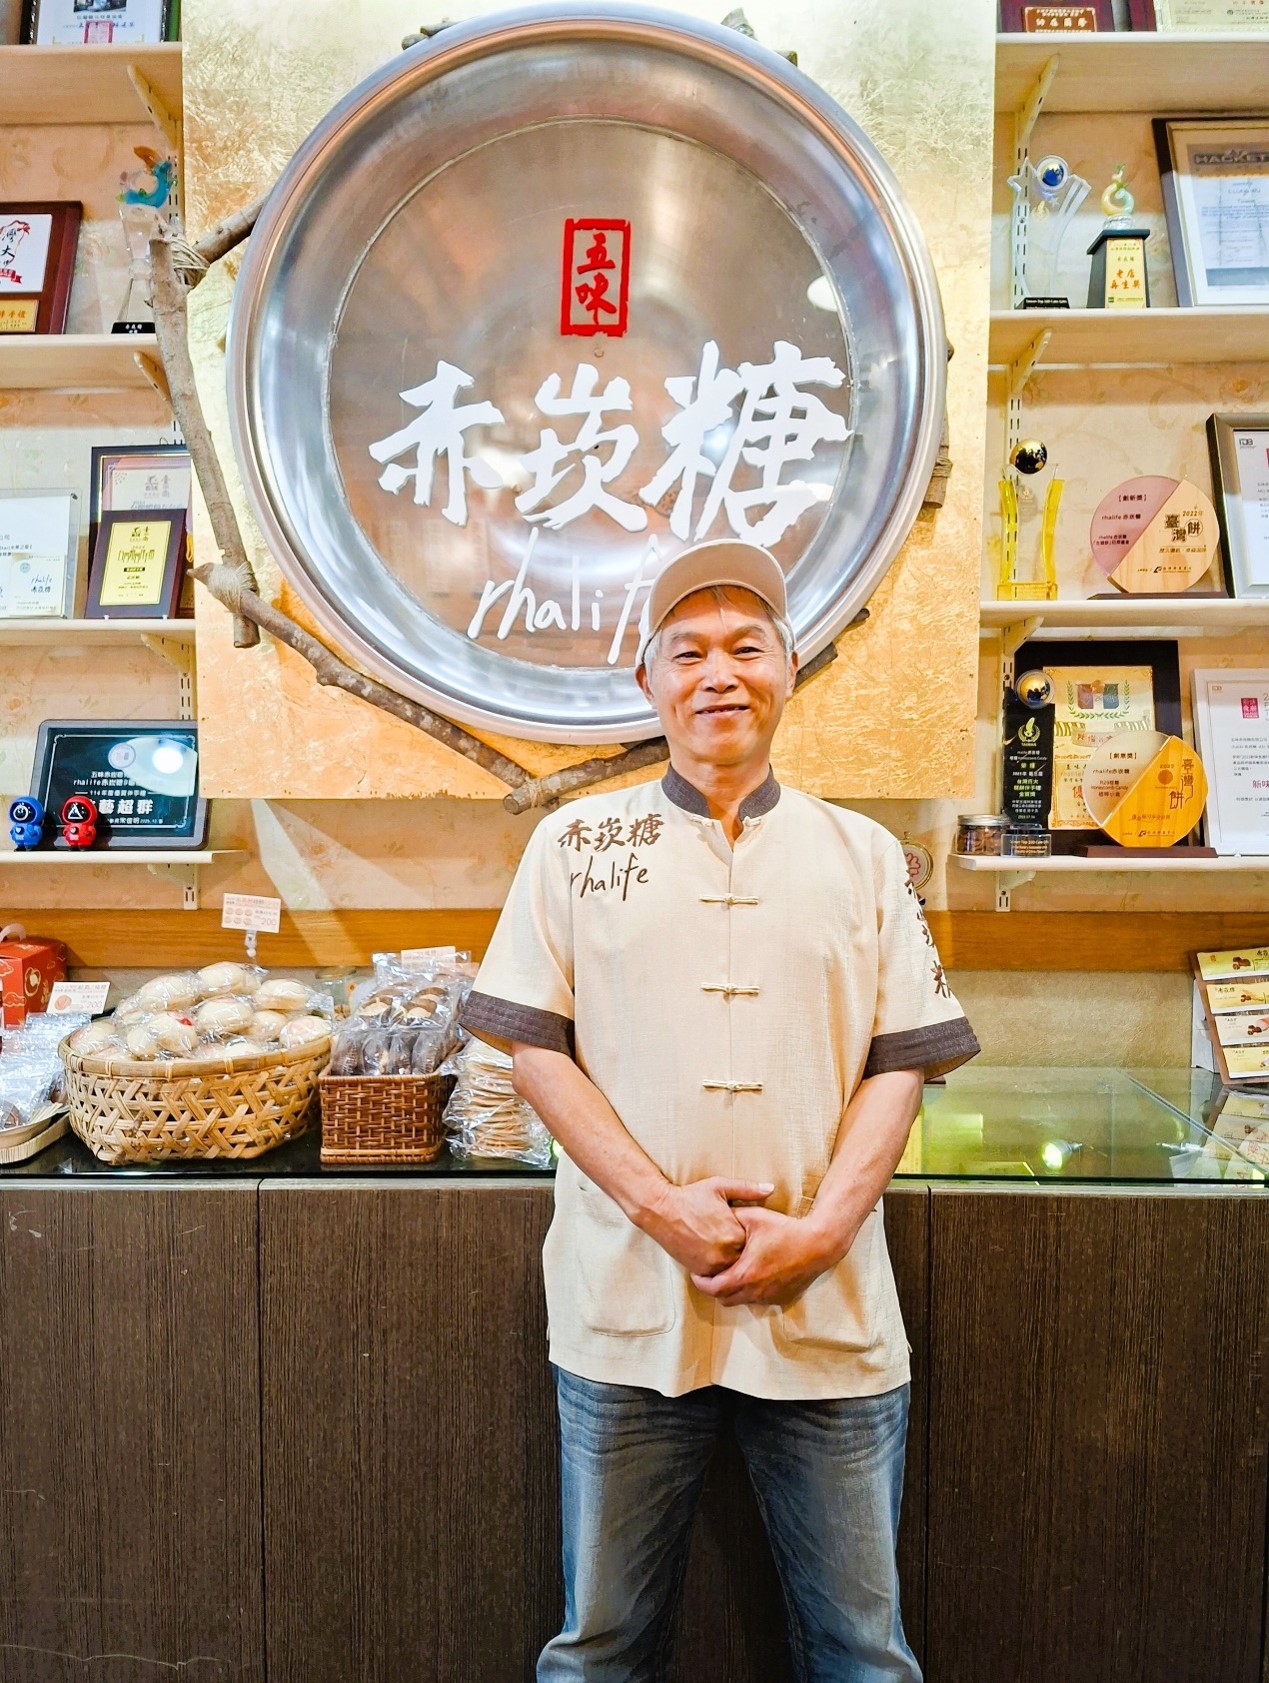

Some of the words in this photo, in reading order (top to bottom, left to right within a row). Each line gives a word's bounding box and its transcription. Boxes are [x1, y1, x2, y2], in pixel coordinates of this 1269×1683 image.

[575, 231, 618, 325] 五味
[368, 339, 855, 547] 赤崁糖
[467, 527, 660, 665] rhalif
[93, 798, 154, 815] 藝超群
[557, 813, 665, 852] 赤崁糖
[570, 851, 649, 901] rhalife
